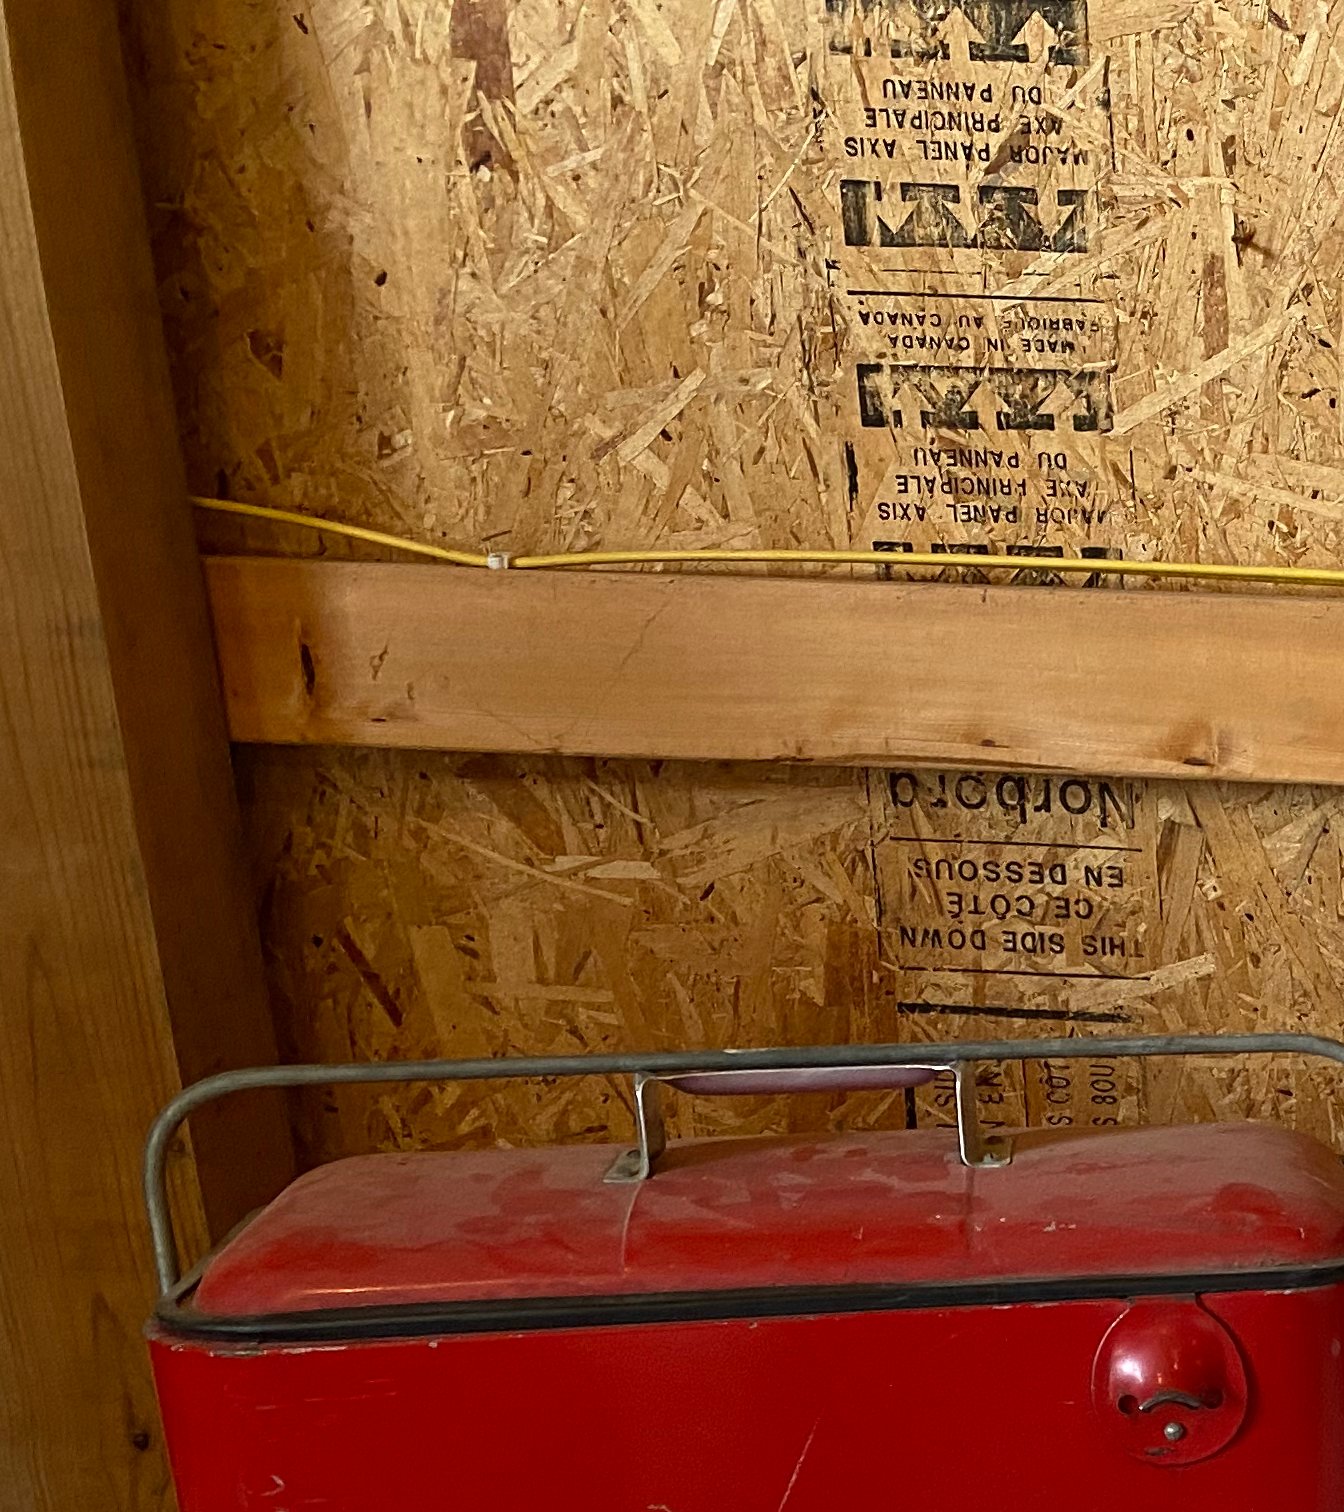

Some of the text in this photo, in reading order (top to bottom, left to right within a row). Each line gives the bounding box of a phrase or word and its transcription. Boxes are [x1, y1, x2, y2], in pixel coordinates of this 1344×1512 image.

[881, 78, 1042, 104] DU PANNEAU
[864, 108, 1063, 134] AXE PRINCIPALE
[843, 137, 1089, 165] MAJOR PANEL AXIS
[858, 310, 941, 329] CANADA
[957, 314, 983, 331] AU
[887, 333, 971, 350] CANADA
[986, 337, 1004, 352] IN
[913, 446, 1067, 470] DU PANNEAU
[876, 502, 927, 522] AXIS
[945, 502, 1018, 525] PANEL
[913, 858, 1124, 888] EN DESSOUS
[1053, 897, 1094, 919] CE
[898, 926, 1144, 958] THIS SIDE DOWN
